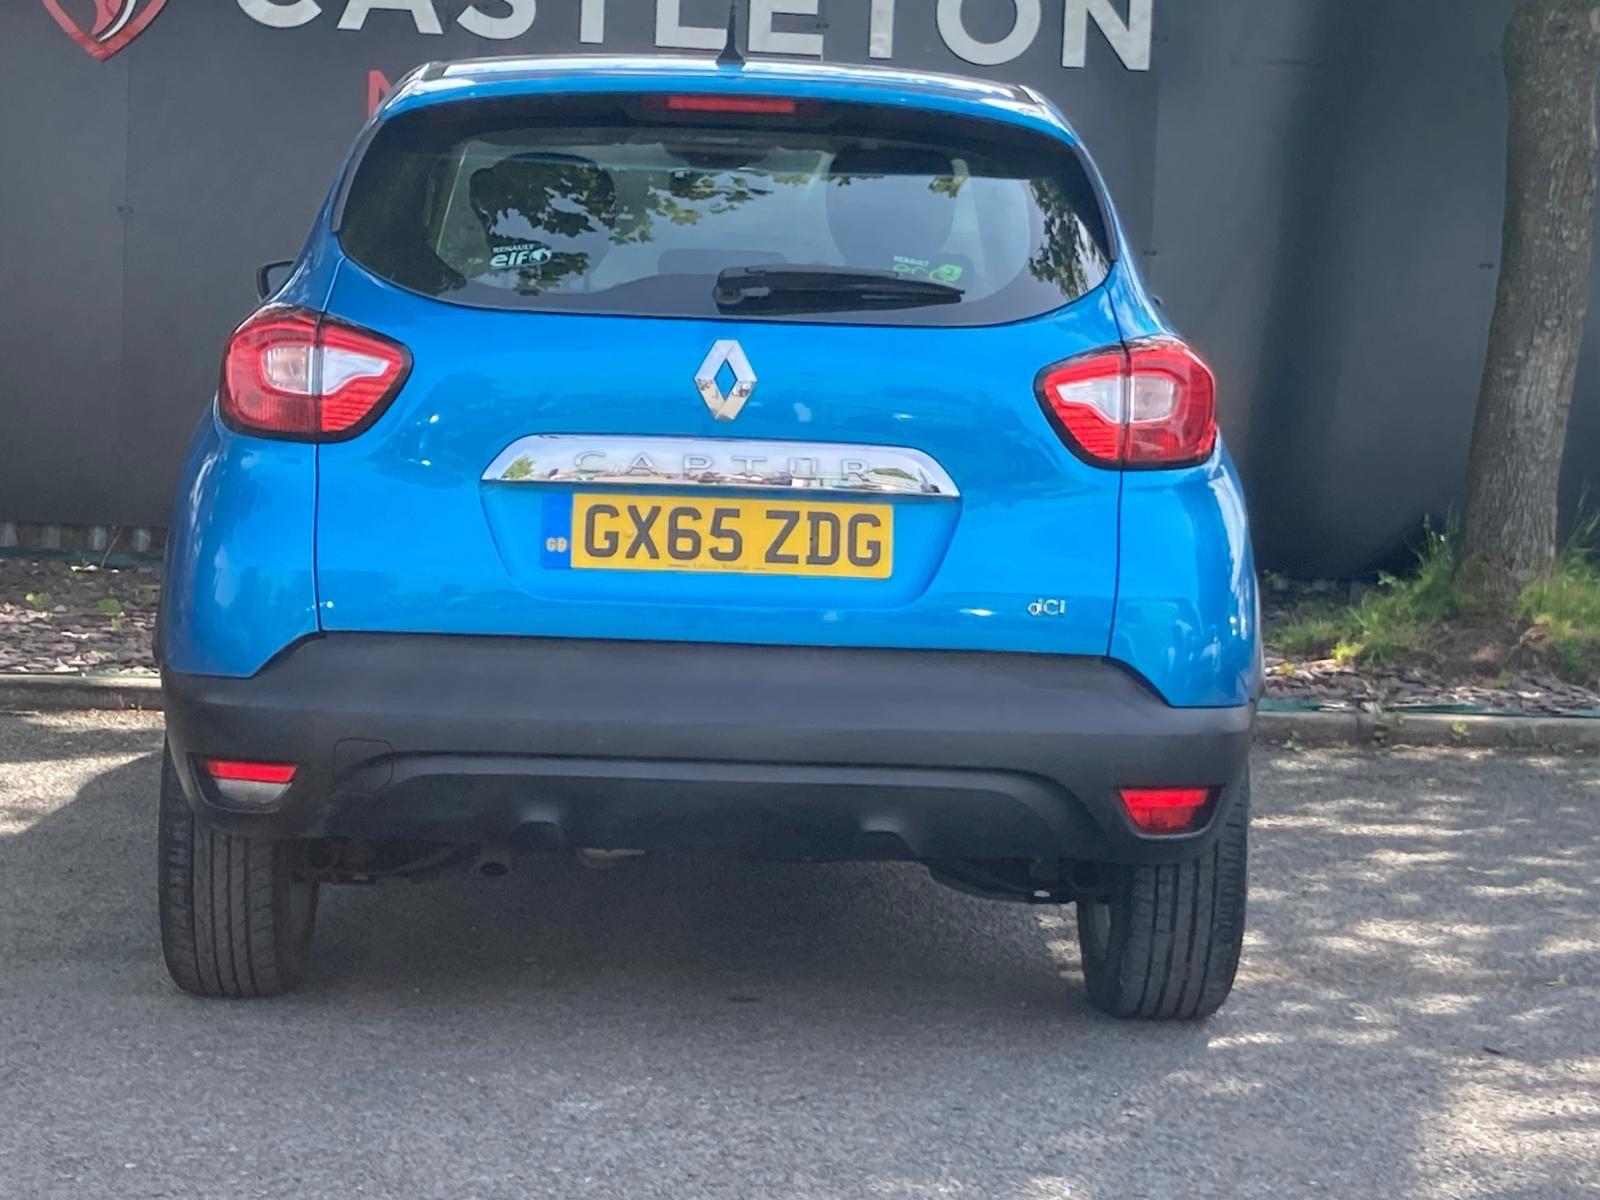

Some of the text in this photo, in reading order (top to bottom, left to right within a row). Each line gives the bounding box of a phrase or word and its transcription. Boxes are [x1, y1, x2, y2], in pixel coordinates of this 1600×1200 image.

[237, 0, 1152, 71] LETON
[573, 451, 871, 482] CAPTUR
[546, 537, 568, 552] GB
[585, 504, 881, 567] GX65 ZDG
